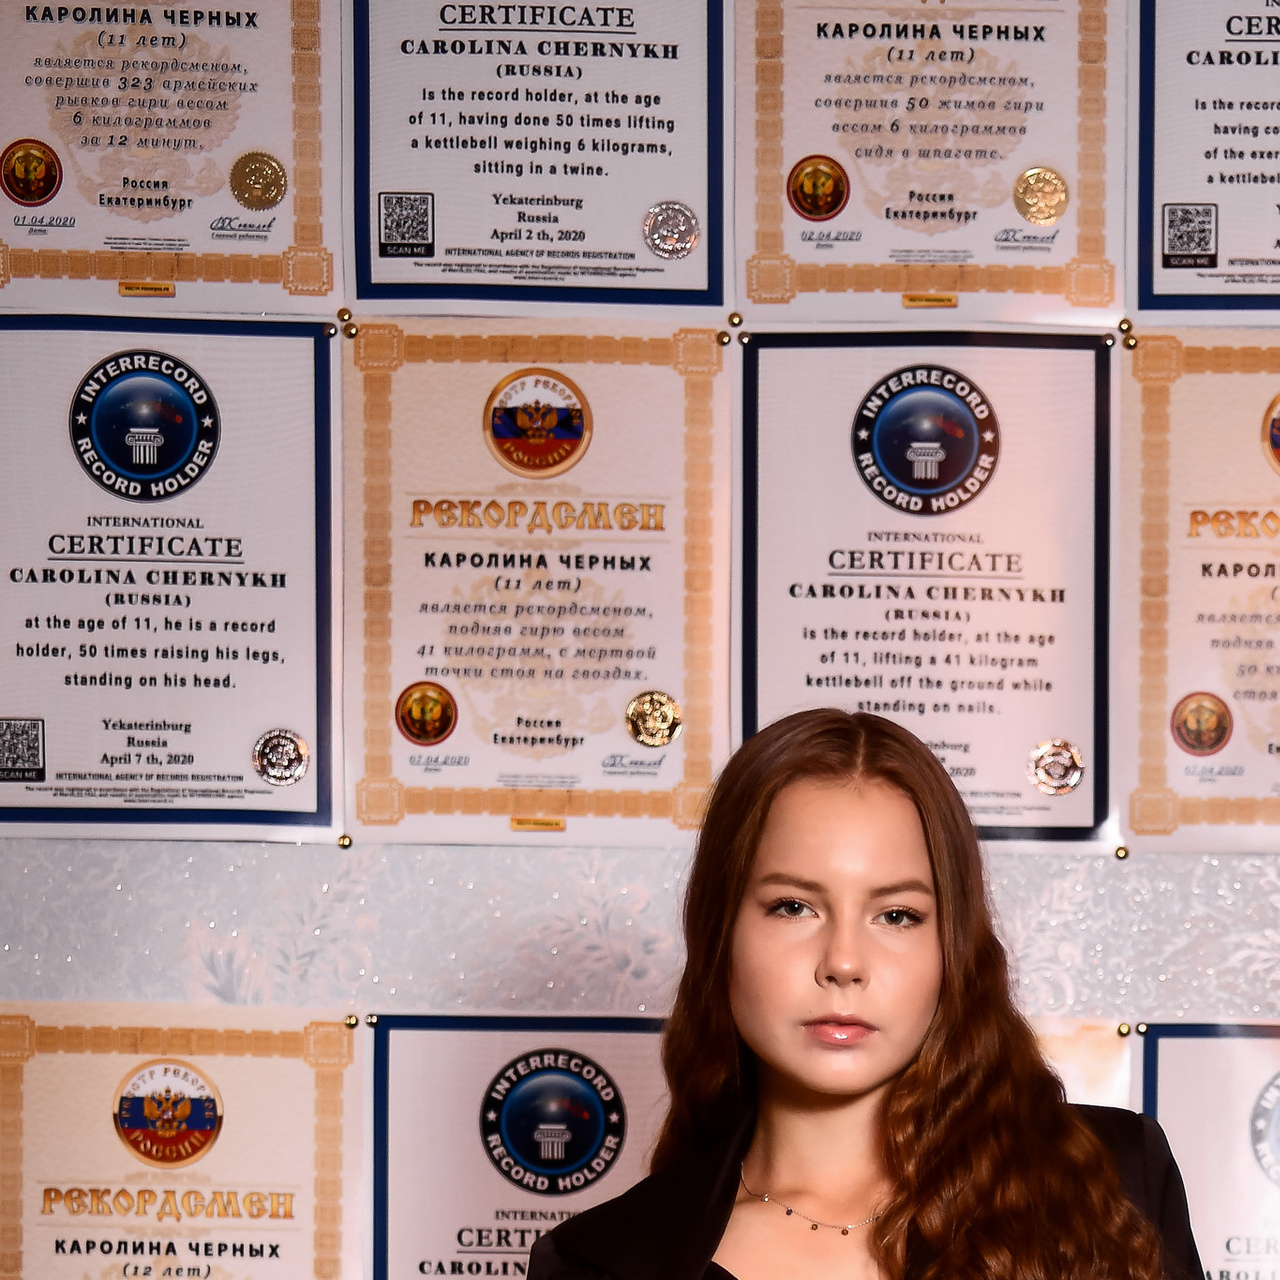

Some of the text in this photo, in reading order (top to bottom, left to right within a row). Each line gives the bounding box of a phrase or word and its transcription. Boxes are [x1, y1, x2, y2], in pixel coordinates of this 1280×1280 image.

[25, 5, 258, 27] КАРОЛИНА ЧЕРНЫХ
[439, 3, 635, 28] CERTIFICATE
[97, 31, 188, 51] (11 лет)
[816, 21, 1045, 42] КАРОЛИНА ЧЕРНЫХ
[400, 38, 679, 59] CAROLINA CHERNYKH
[496, 63, 583, 80] (RUSSIA)
[24, 73, 259, 94] совершив 323 армейских
[408, 110, 675, 133] of 11, having done 50 times lifting
[122, 176, 169, 191] Россия
[98, 192, 193, 213] Екатеринбург
[13, 215, 76, 227] 01.04.2020
[490, 227, 586, 243] April 2 th, 2020
[80, 354, 208, 405] INTERRECORD
[77, 437, 214, 497] RECORD HOLDER
[86, 515, 205, 529] INTERNATIONAL
[409, 498, 666, 535] РЕКОРДСМЕН
[48, 533, 243, 557] CERTIFICATE
[424, 551, 651, 571] КАРОЛИНА ЧЕРНЫХ
[9, 567, 287, 588] CAROLINA CHERNYKH
[16, 641, 285, 665] holder, 50 times raising his legs,
[40, 1186, 295, 1223] РЕКОРДСМЕН
[54, 1239, 280, 1258] КАРОЛИНА ЧЕРНЫХ
[122, 1262, 211, 1279] (12 лет)
